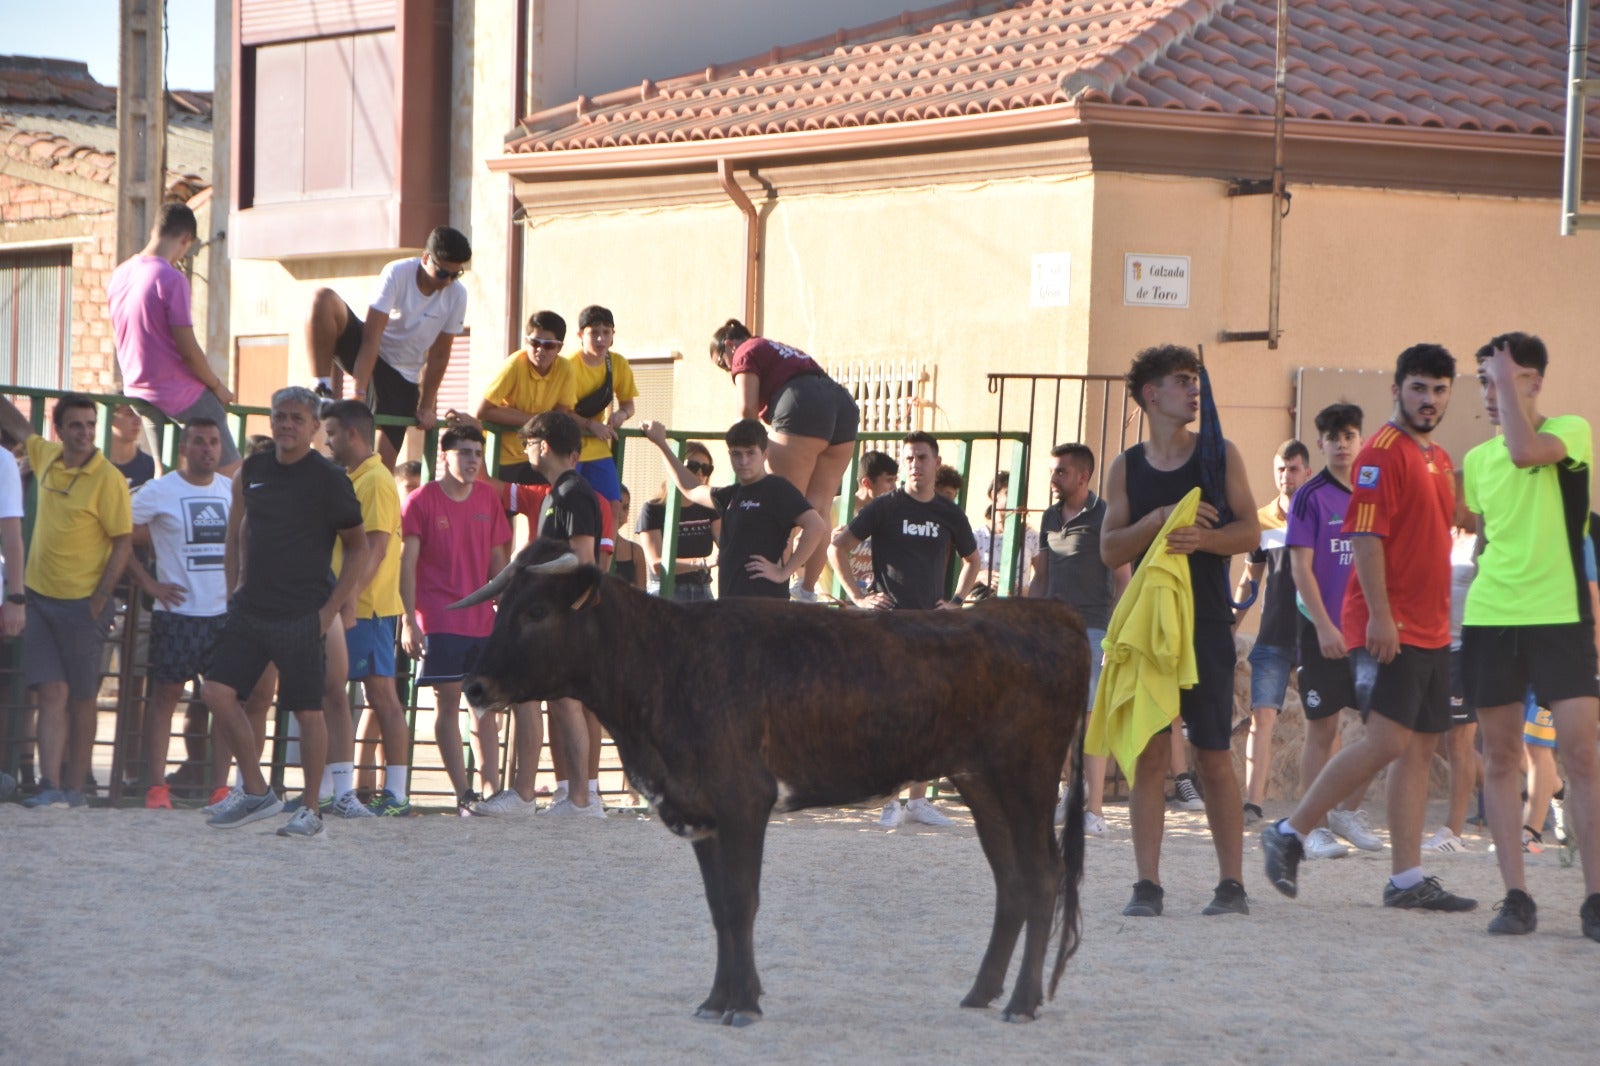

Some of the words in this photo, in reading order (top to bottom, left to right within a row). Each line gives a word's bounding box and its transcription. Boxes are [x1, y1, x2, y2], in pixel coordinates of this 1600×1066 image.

[1149, 265, 1185, 278] Calzada
[1136, 286, 1148, 299] de
[1152, 285, 1178, 300] Toro
[193, 519, 225, 527] adidas
[903, 519, 940, 538] levi's
